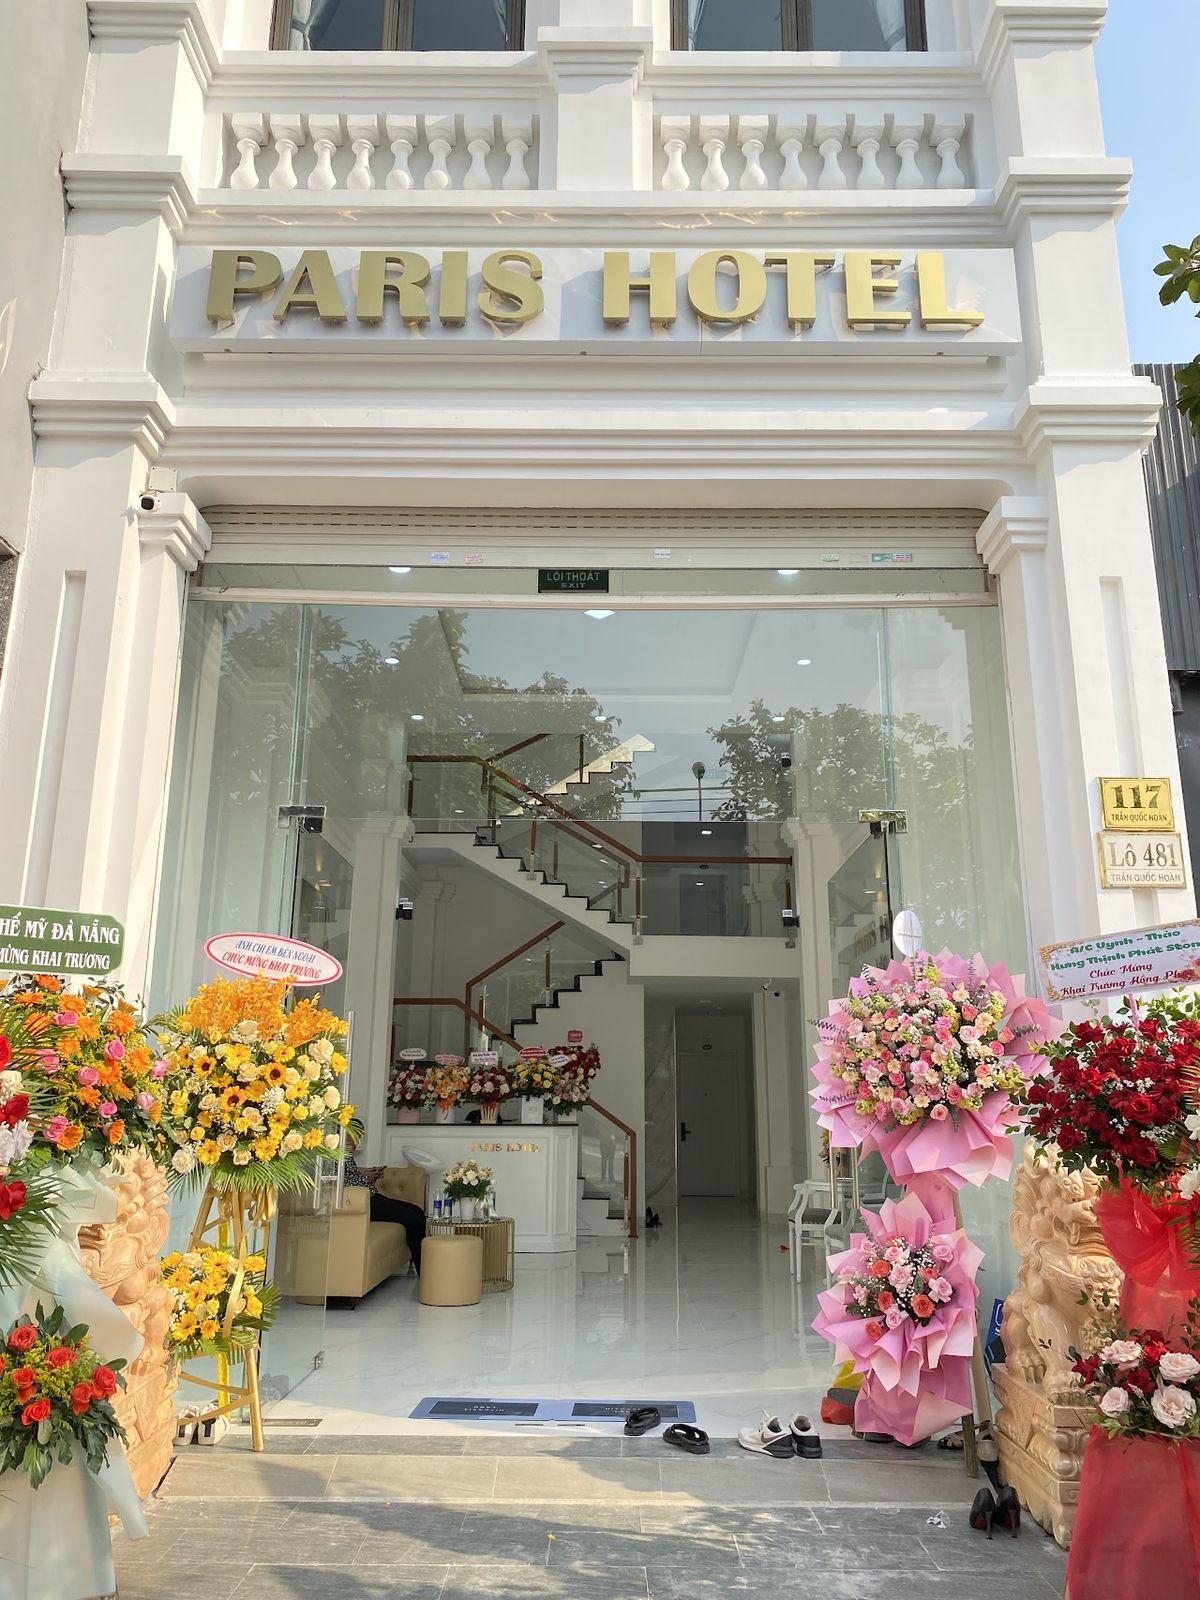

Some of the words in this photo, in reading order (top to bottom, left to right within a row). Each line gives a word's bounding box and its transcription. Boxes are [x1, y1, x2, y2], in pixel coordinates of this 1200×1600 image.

[205, 249, 545, 326] PARIS
[602, 249, 986, 330] HOTEL
[1110, 784, 1162, 809] 117
[1108, 842, 1137, 868] Lô
[1143, 842, 1179, 867] 481
[24, 917, 48, 939] MỸ
[51, 919, 75, 941] ĐÀ
[78, 918, 120, 945] NẴNG
[31, 949, 63, 967] KHAI
[64, 951, 111, 970] TRƯƠNG
[235, 940, 253, 952] ANH
[265, 945, 280, 957] EM
[222, 950, 244, 965] CHÚC
[268, 960, 289, 973] KHAI
